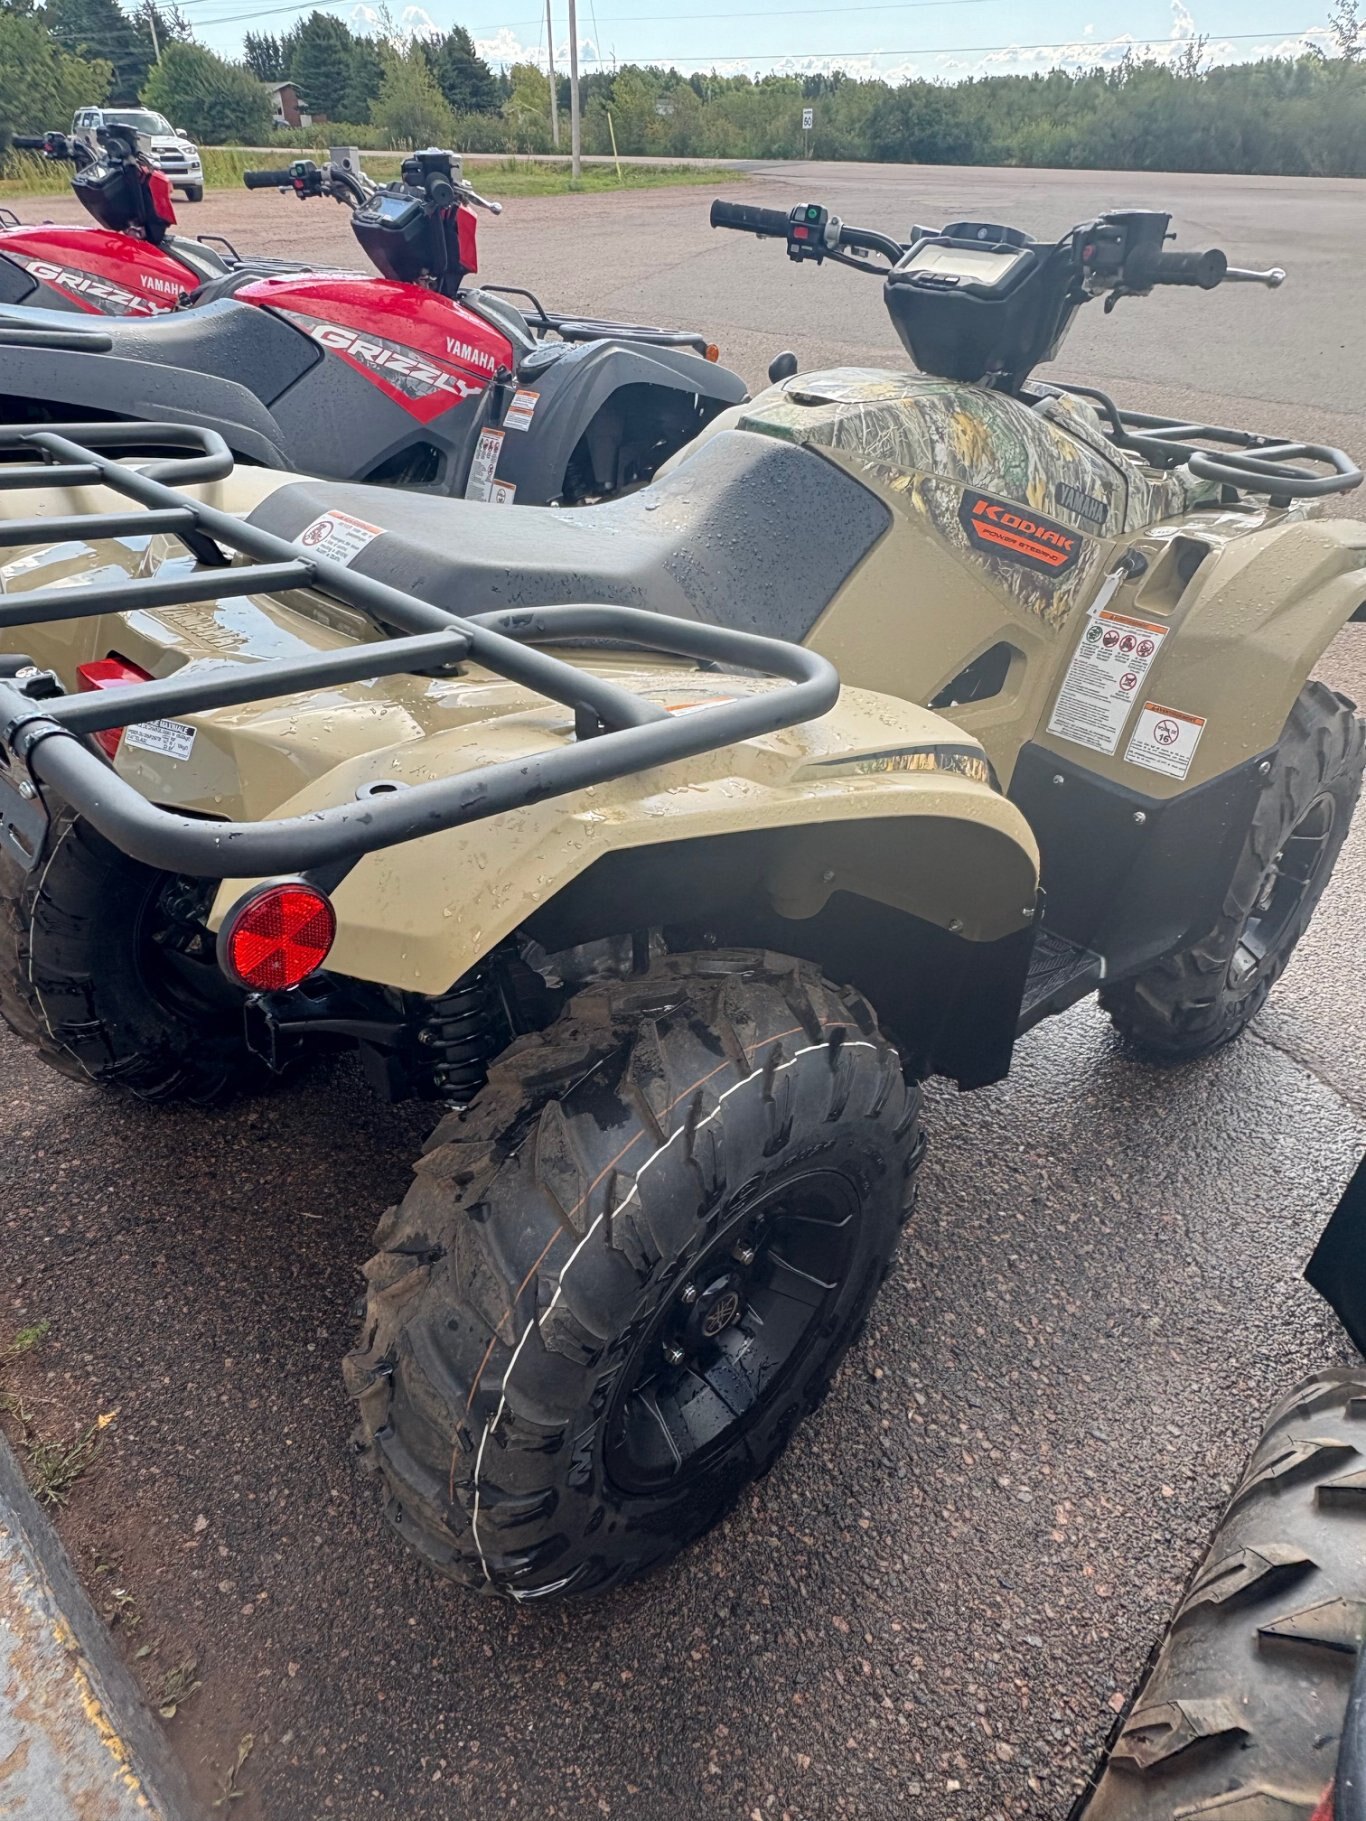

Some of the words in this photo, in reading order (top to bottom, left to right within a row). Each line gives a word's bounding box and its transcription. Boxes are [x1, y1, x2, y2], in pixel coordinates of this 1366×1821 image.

[26, 261, 172, 315] GRIZZLY
[140, 274, 186, 295] YAMAHA
[311, 324, 482, 398] GRIZZLY
[446, 336, 495, 371] YAMAHA
[1061, 484, 1104, 523] YAMAHA
[972, 500, 1074, 551] KODIAK
[982, 528, 1017, 546] POWER
[1018, 542, 1059, 561] STEERING
[1158, 733, 1170, 743] 16
